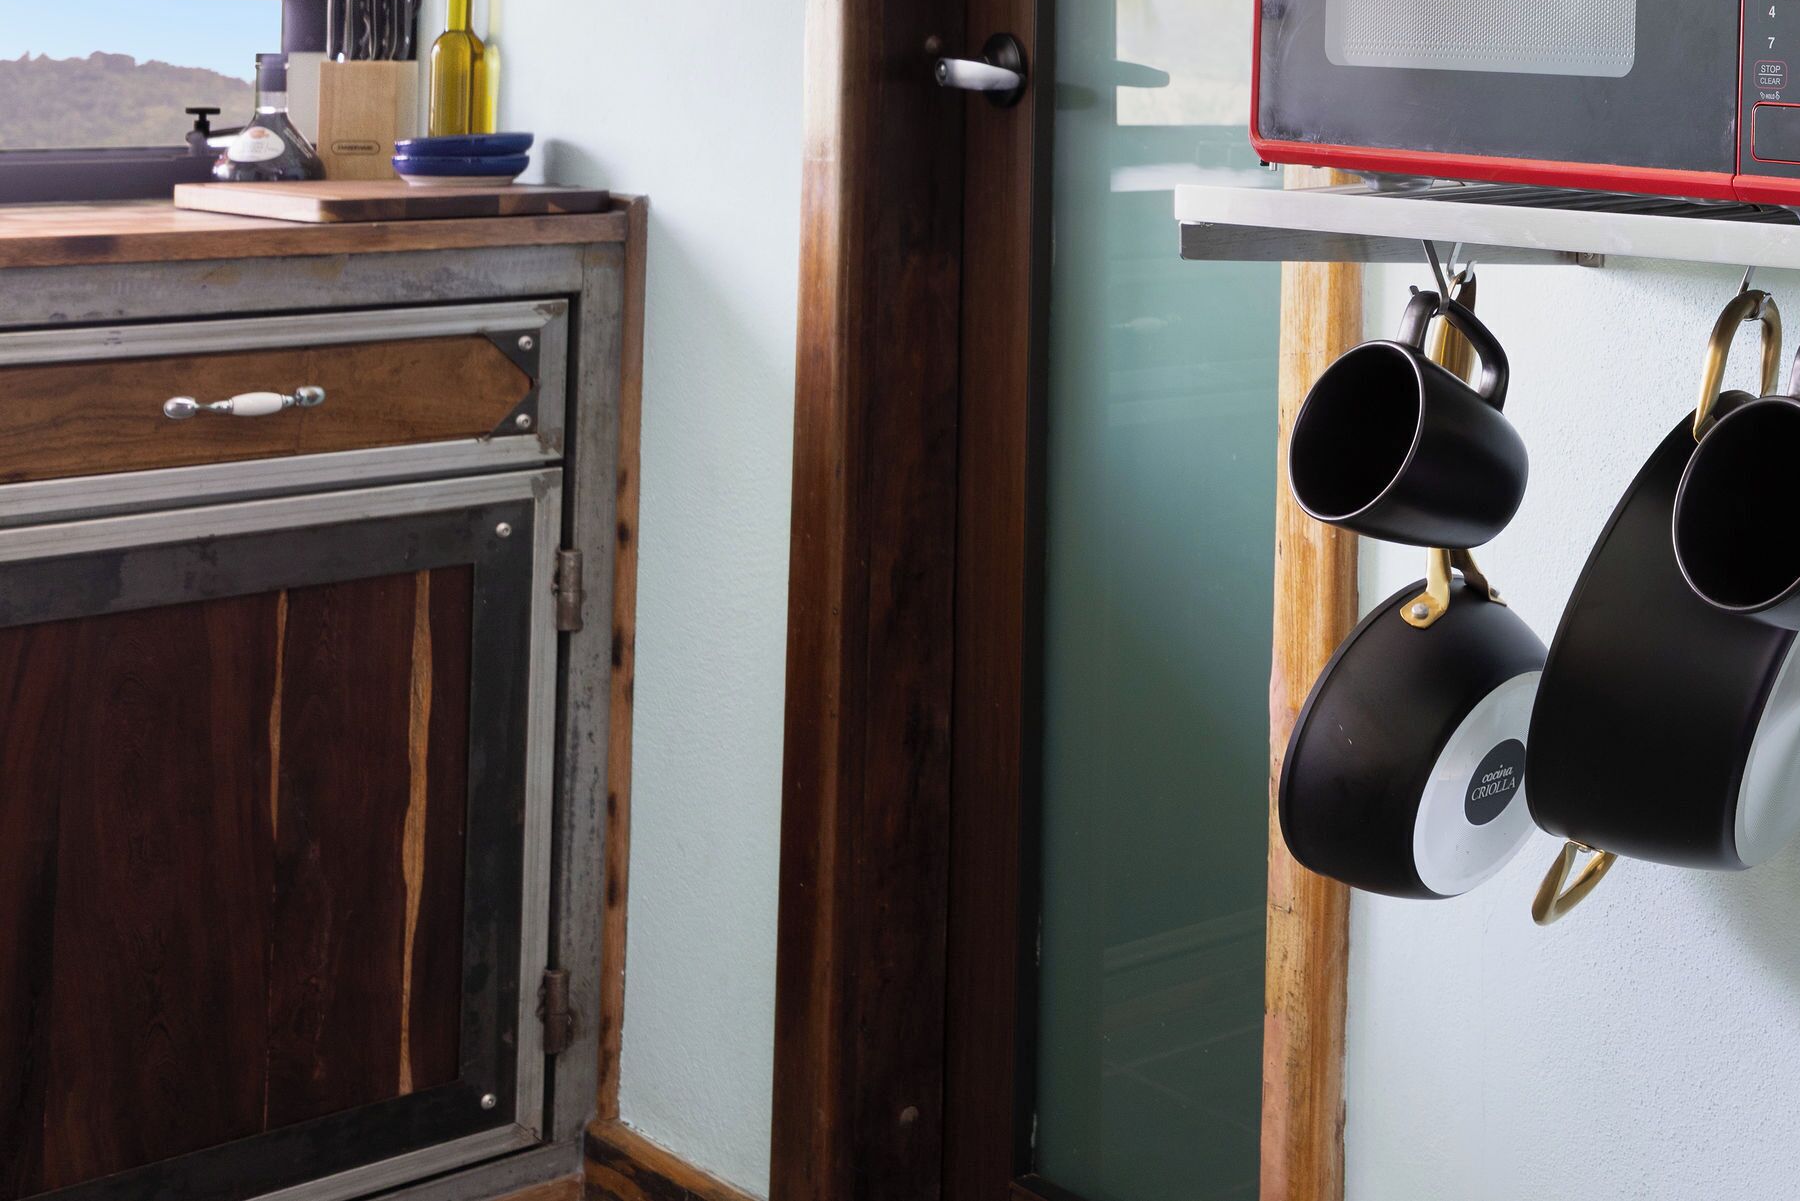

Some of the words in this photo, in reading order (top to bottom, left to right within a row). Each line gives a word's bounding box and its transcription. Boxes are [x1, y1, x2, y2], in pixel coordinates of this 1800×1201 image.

[1769, 6, 1776, 18] 4
[1768, 37, 1775, 49] 7
[1760, 65, 1780, 73] STOP
[1482, 764, 1513, 783] cocina
[1472, 777, 1516, 800] CRIOLLA
